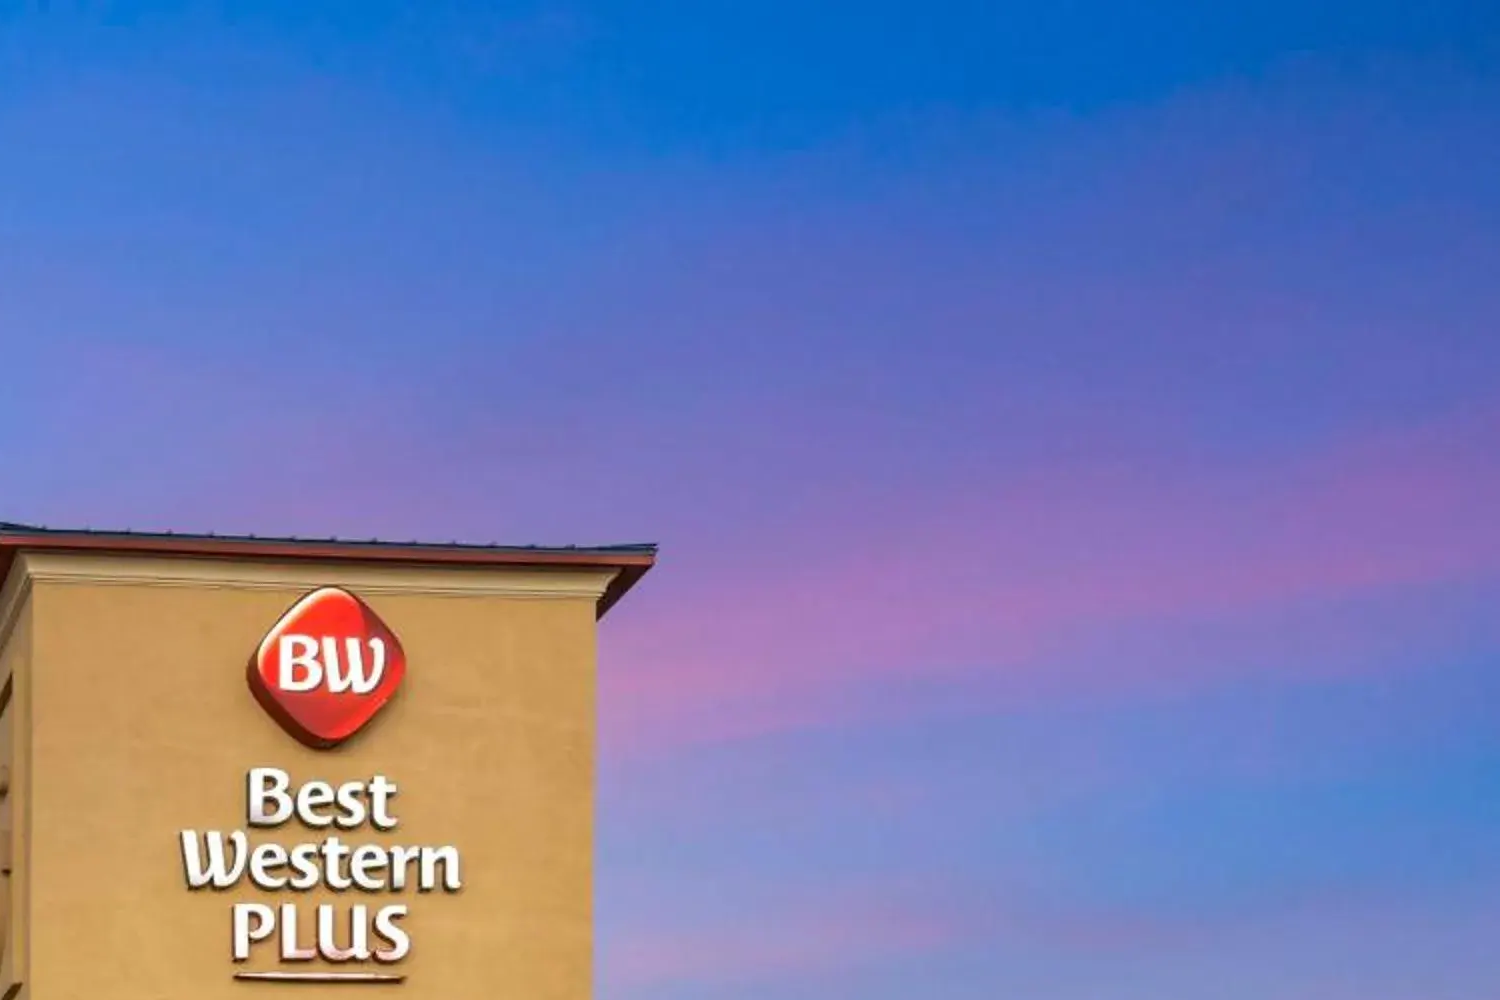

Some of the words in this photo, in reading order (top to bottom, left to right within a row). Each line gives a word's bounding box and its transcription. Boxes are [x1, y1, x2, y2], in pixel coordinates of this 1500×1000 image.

[278, 634, 385, 694] BW
[247, 767, 398, 829] Best
[181, 830, 462, 892] Western
[233, 903, 411, 962] PLUS
